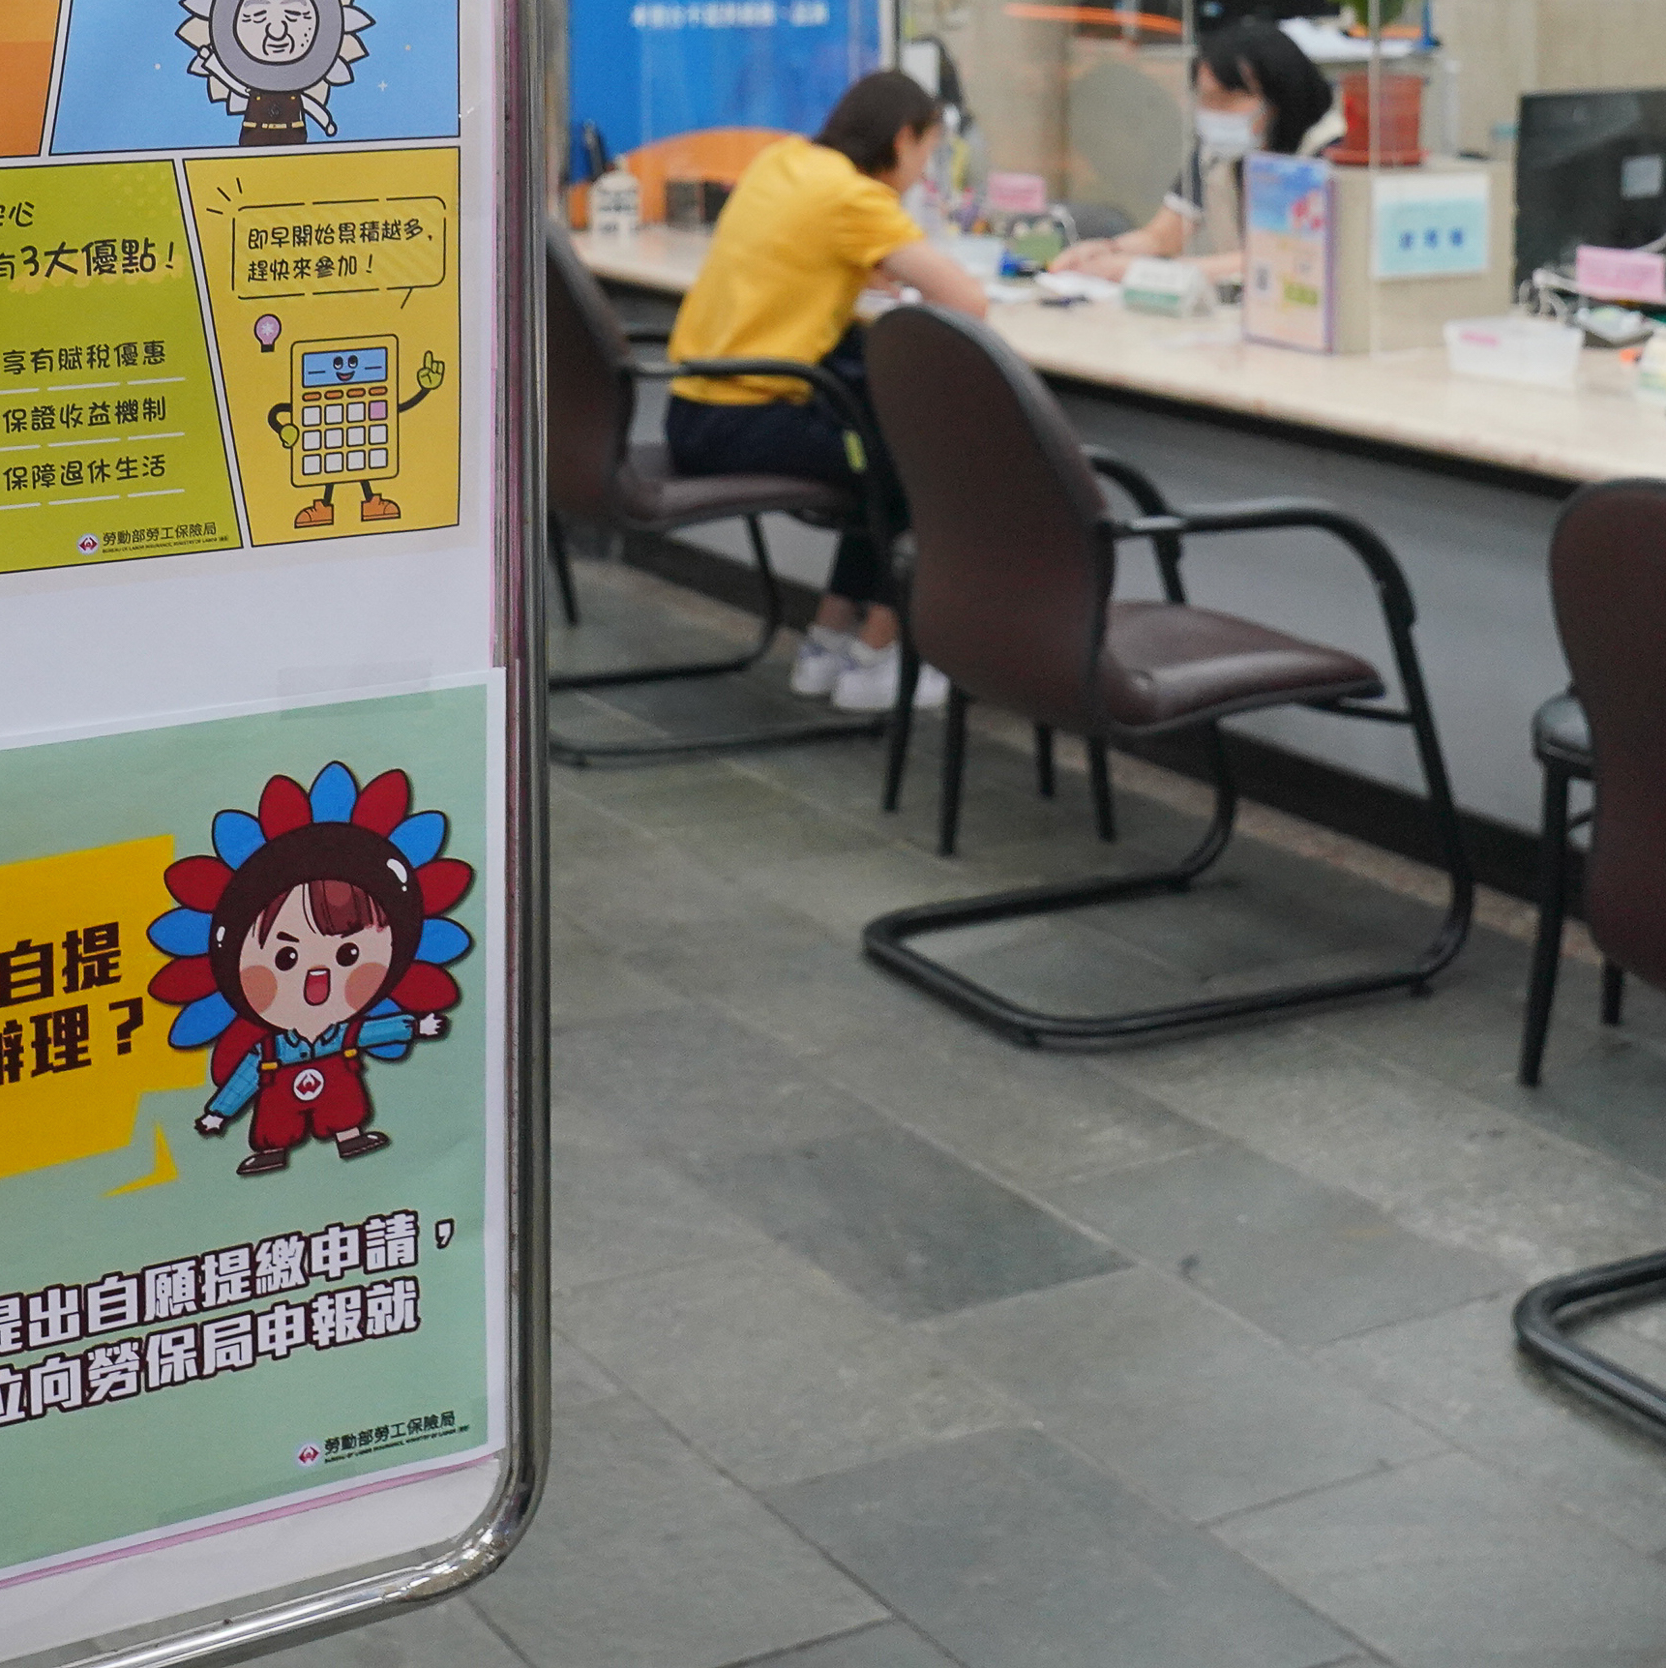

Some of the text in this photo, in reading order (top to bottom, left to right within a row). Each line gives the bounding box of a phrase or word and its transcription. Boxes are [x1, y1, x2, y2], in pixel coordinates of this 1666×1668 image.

[2, 395, 167, 434] 保證收益機制
[2, 453, 167, 492] 保障退休生活
[102, 521, 217, 547] 勞動部勞工保險局
[324, 1410, 456, 1456] 勞動部勞工保險局
